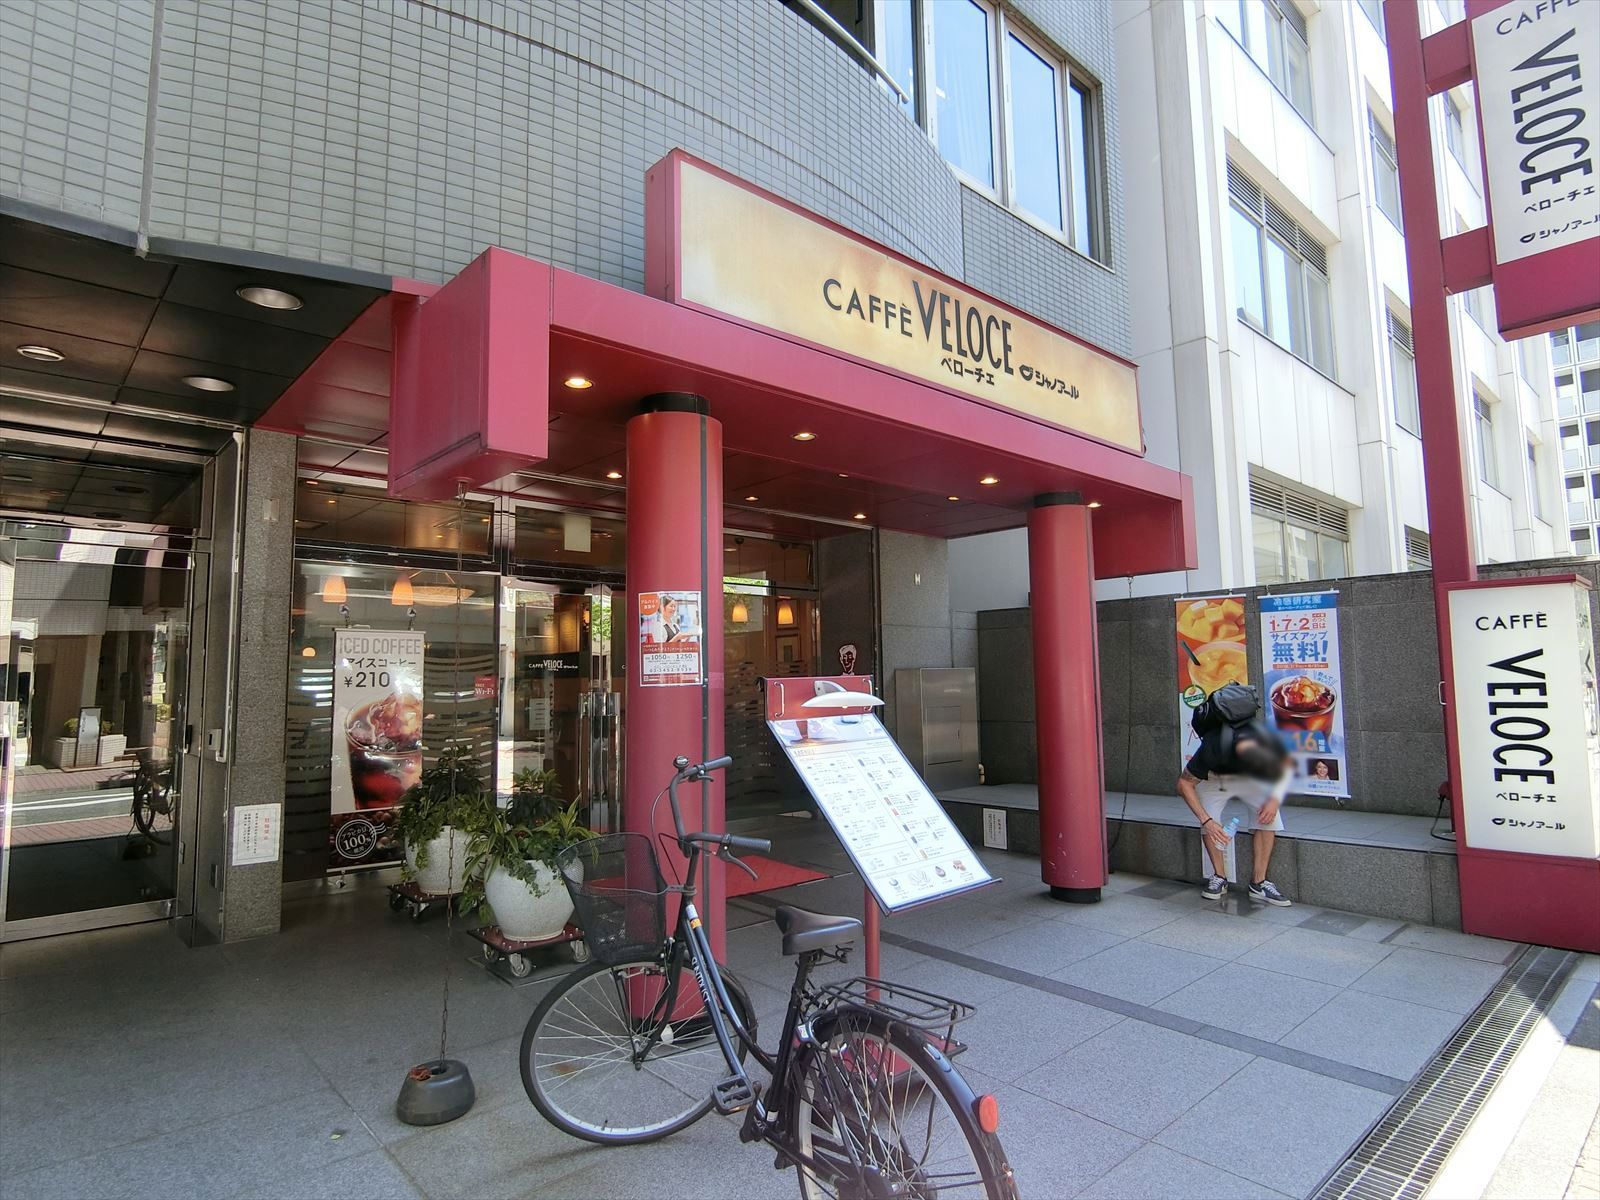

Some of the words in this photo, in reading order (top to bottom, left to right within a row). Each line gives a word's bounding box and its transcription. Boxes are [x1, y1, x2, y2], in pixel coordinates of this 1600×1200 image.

[1510, 27, 1593, 196] VELOCE
[1523, 185, 1596, 214] ベローチェ
[823, 278, 913, 338] CAFFÈ
[912, 279, 1014, 376] VELOCE
[940, 357, 995, 386] ベローチェ
[1035, 370, 1080, 400] シャノアール
[1475, 611, 1548, 631] CAFFÈ
[340, 637, 369, 654] ICED
[373, 638, 422, 655] COFFEE
[1270, 631, 1328, 642] サイズアップ
[543, 659, 563, 669] VELOCE
[1486, 648, 1555, 785] VELOCE
[1496, 792, 1557, 803] ベローチェ
[1508, 819, 1566, 831] シャノアール
